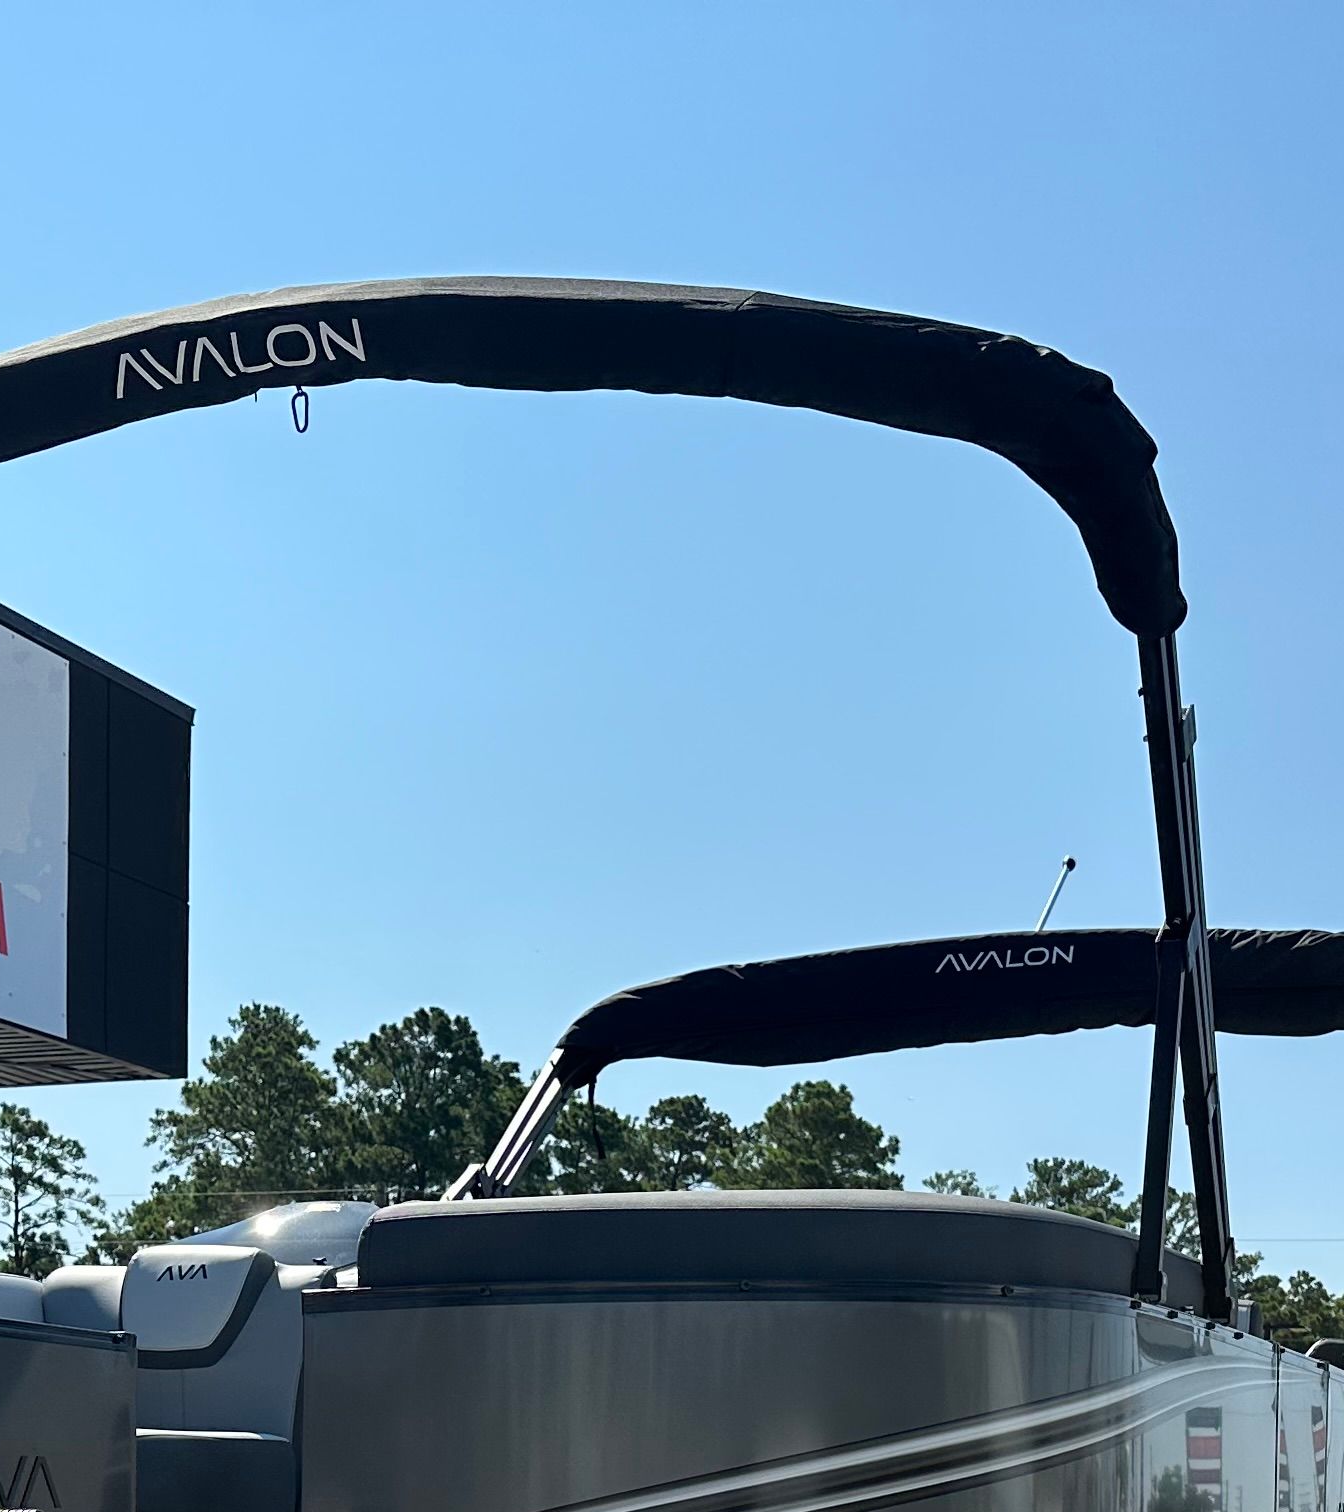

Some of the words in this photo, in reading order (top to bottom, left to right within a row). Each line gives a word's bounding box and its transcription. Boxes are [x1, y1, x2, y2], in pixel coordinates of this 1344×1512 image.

[116, 318, 366, 399] AVALON
[935, 945, 1074, 973] AVALON
[156, 1263, 208, 1282] AVA
